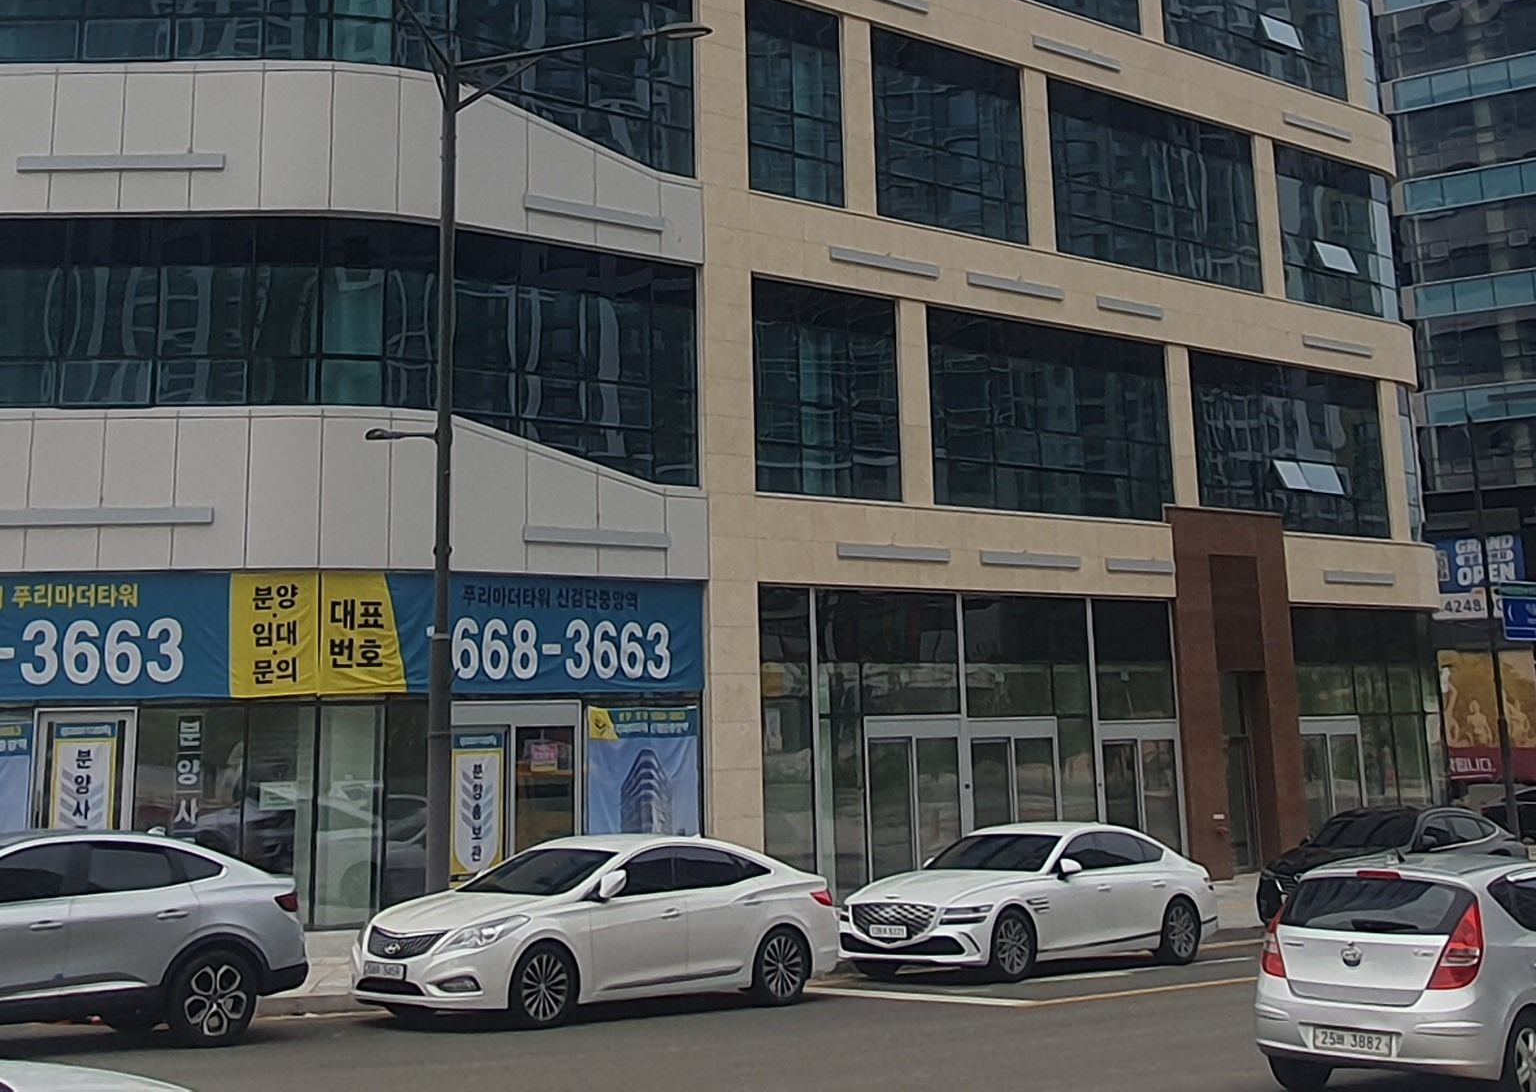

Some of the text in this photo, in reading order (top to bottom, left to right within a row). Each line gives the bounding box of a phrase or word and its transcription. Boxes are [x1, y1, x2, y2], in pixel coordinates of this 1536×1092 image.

[1456, 561, 1516, 586] OPEN
[252, 582, 298, 611] 분양
[556, 587, 639, 612] 신검단중앙역
[330, 598, 384, 631] 대표
[252, 621, 298, 648] 임대
[427, 617, 671, 681] 668-3663
[329, 637, 384, 669] 번호
[251, 657, 298, 685] 문의
[72, 749, 94, 829] 분양사
[173, 720, 202, 842] 분양사
